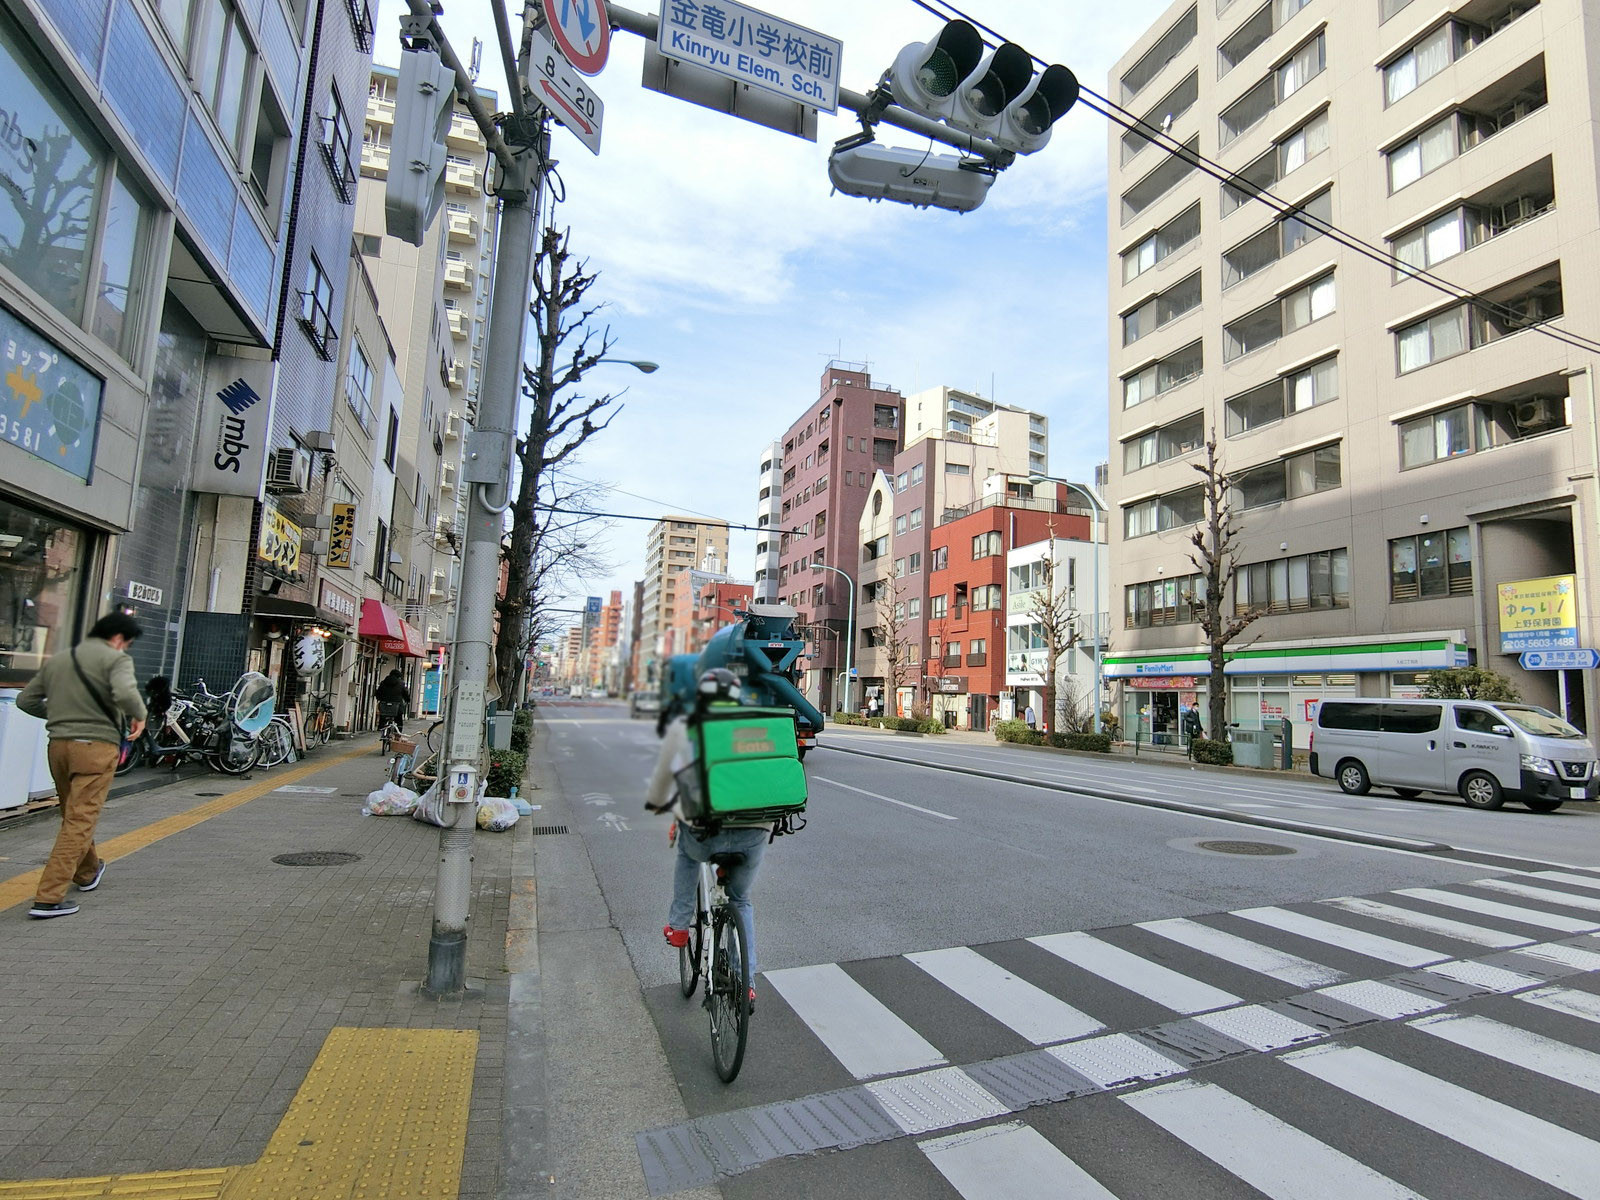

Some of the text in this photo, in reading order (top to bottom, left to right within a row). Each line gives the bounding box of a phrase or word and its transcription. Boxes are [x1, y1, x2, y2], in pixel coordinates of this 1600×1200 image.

[670, 0, 833, 79] 金竜小学校前
[672, 30, 827, 102] Kinryu Elem. Sch.
[265, 529, 297, 569] タンメン
[330, 514, 346, 562] タンメン
[1514, 616, 1562, 629] 上野保育園
[1144, 664, 1174, 673] FamilyMart
[1546, 651, 1587, 661] 言問通り
